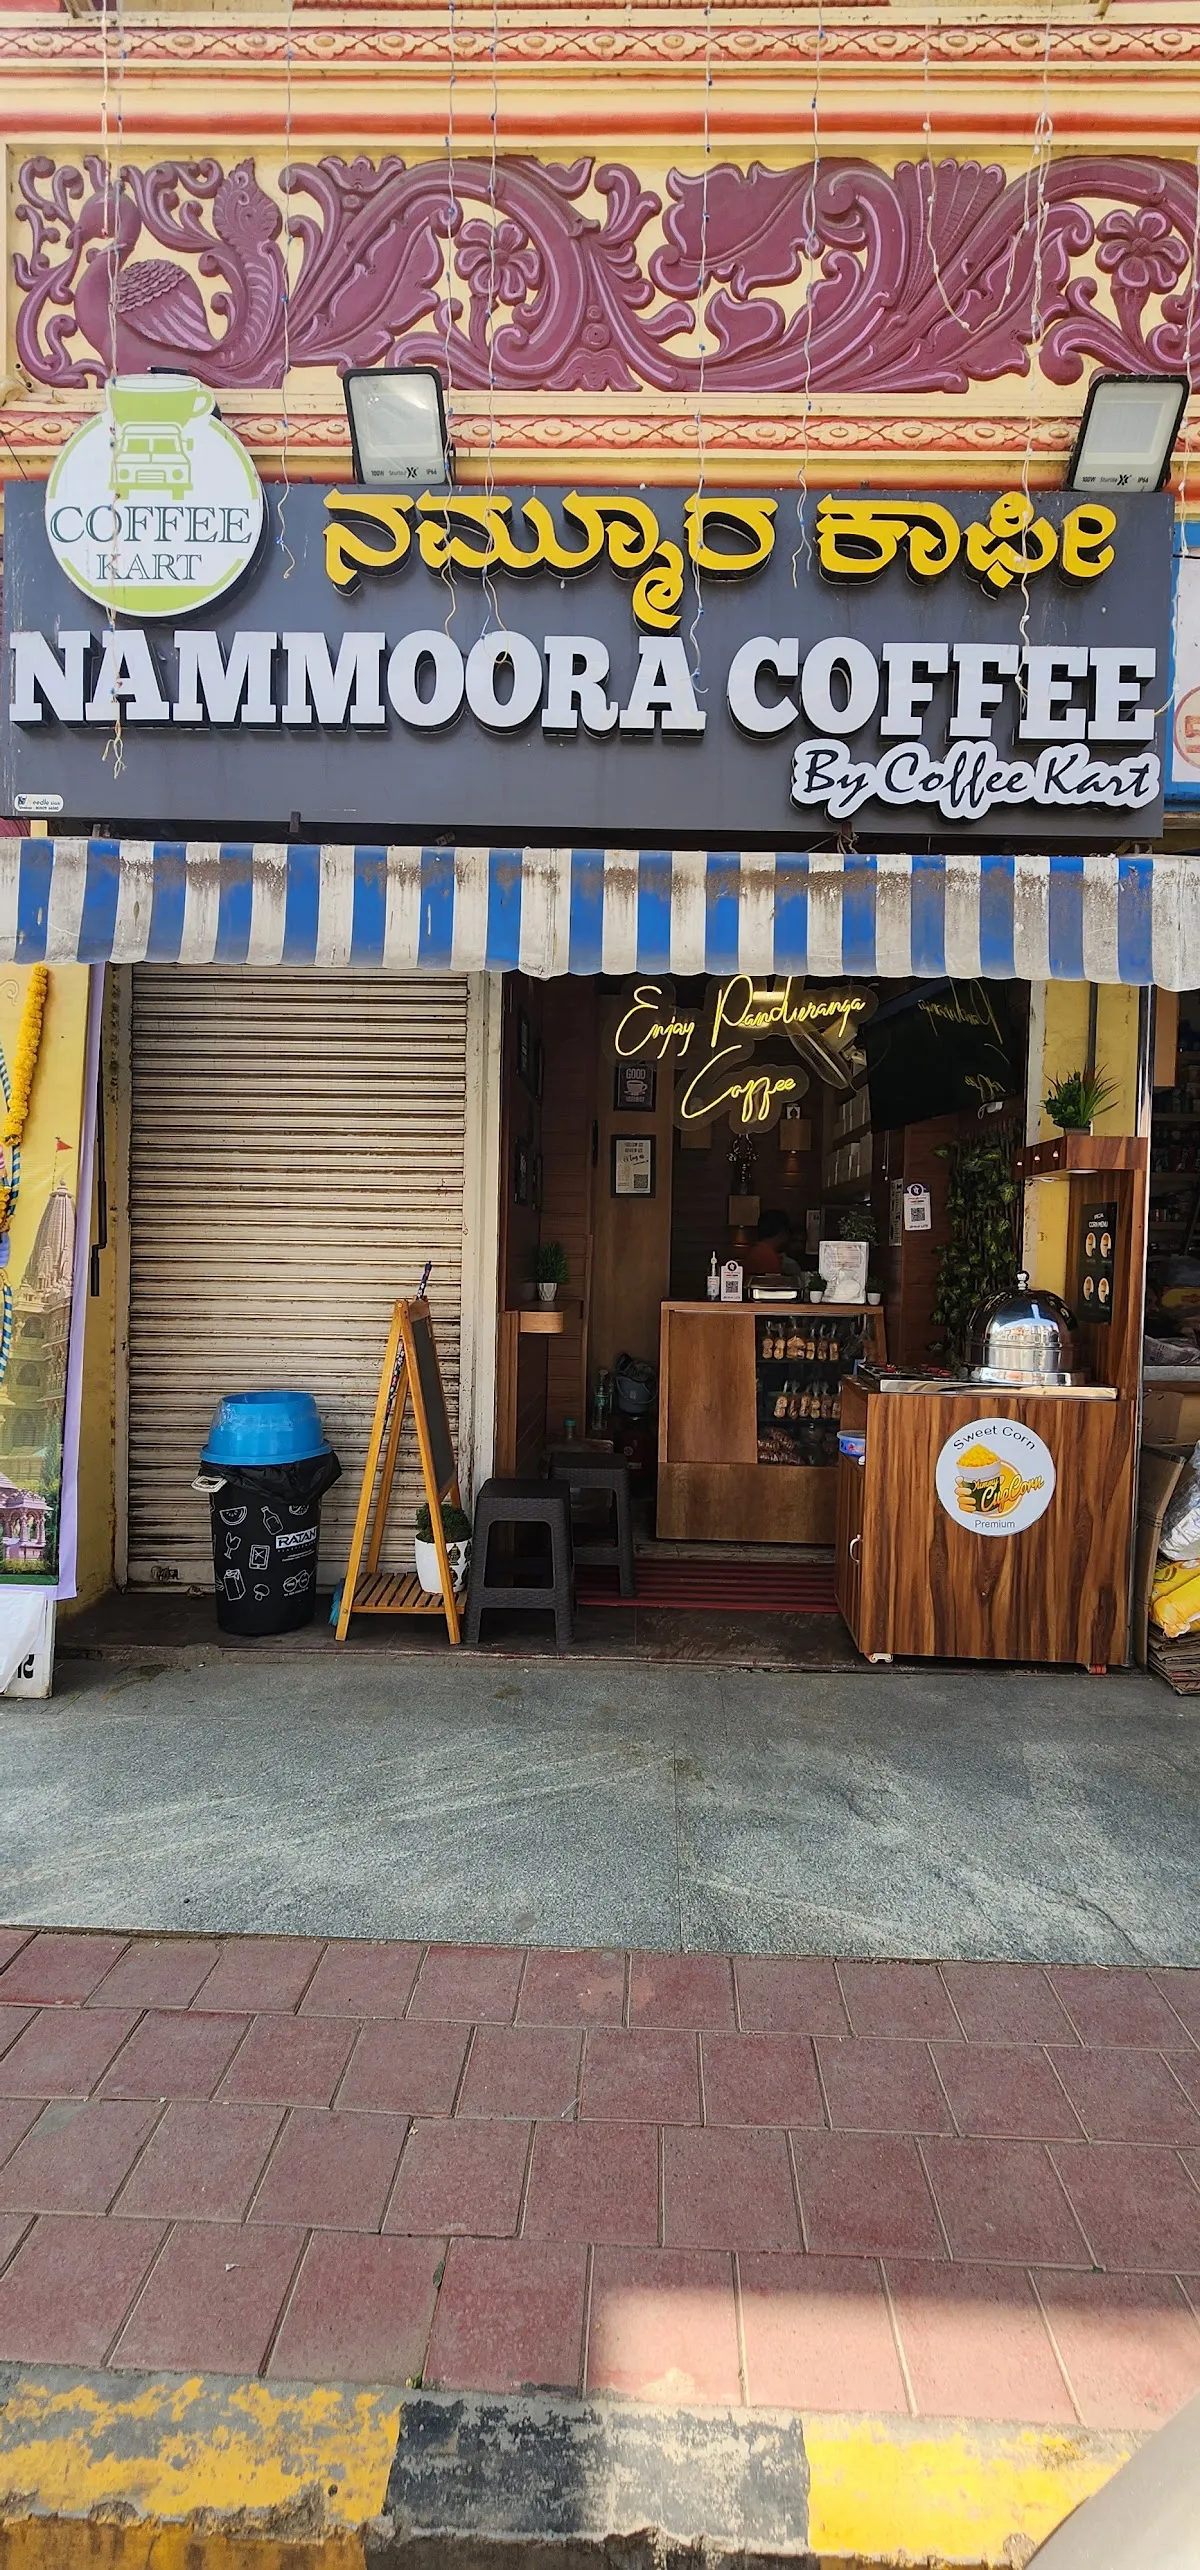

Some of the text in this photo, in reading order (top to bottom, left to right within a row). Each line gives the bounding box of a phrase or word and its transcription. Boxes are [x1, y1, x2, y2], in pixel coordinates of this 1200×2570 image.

[50, 506, 251, 544] COFFEE
[96, 553, 202, 581] KART
[323, 489, 778, 629] ನಮ್ಮೂರ
[10, 630, 1156, 741] NAMMOORA COFFEE
[804, 750, 1151, 808] By Coffee Kart
[615, 975, 866, 1059] Enjoy Panduranga
[626, 1068, 646, 1080] GOOD
[681, 1045, 796, 1122] Coffee
[953, 1425, 1036, 1451] Sweet Corn
[277, 1527, 316, 1547] RATAN
[974, 1519, 1016, 1529] Premium
